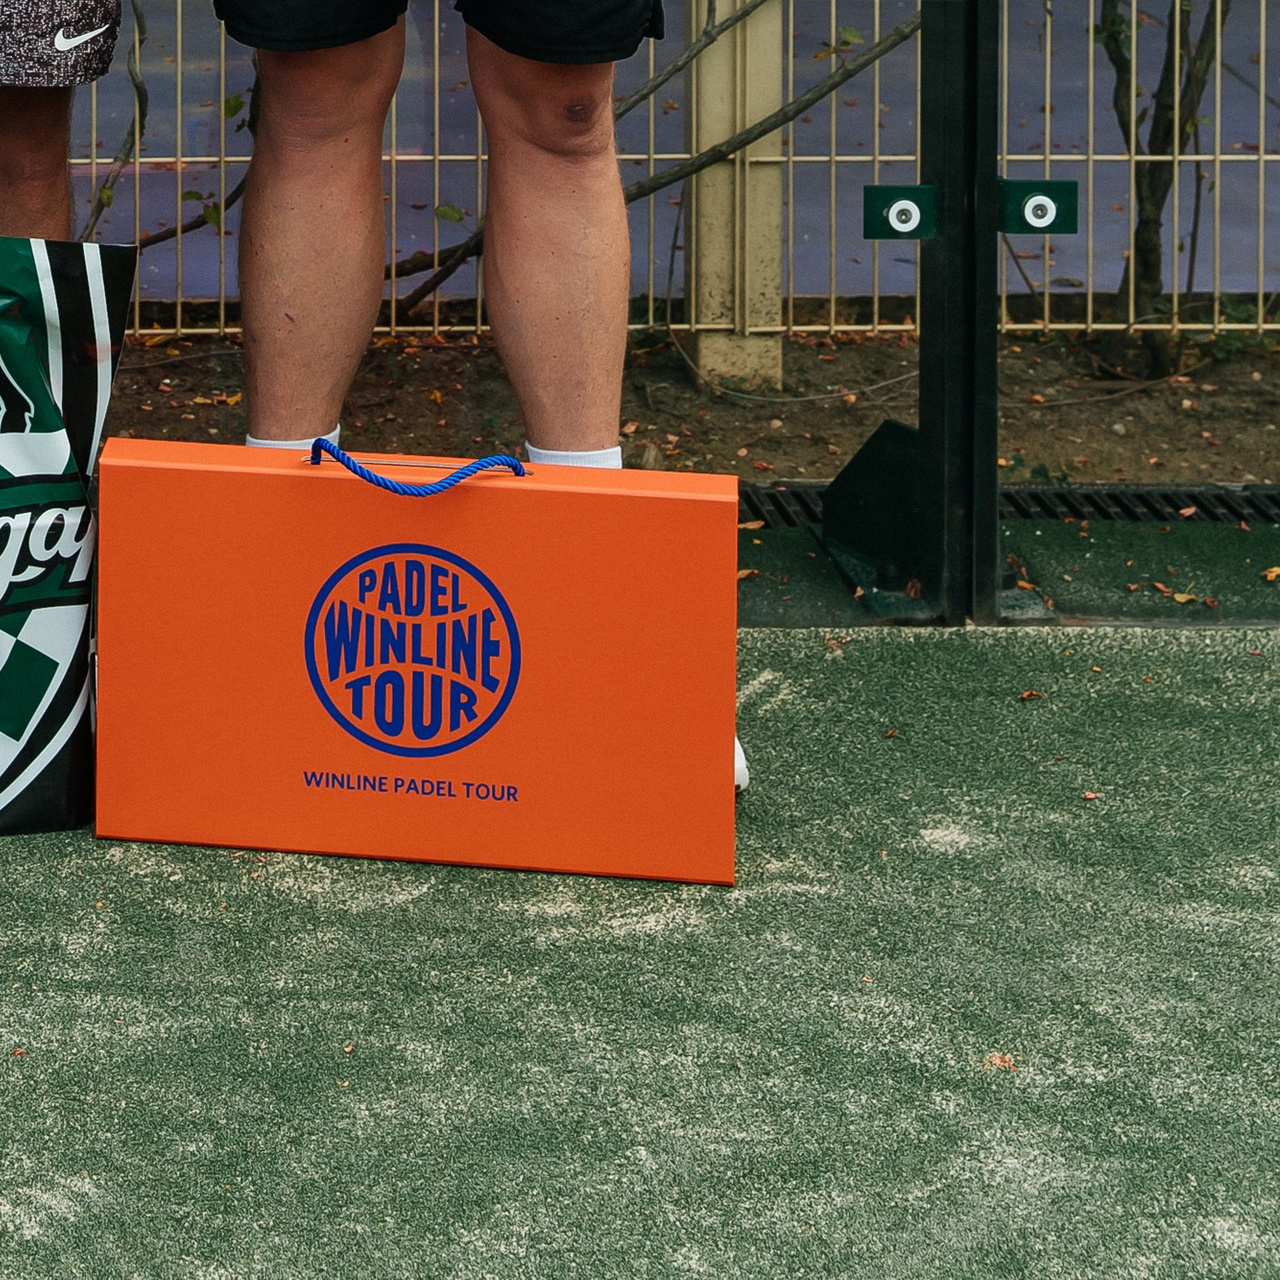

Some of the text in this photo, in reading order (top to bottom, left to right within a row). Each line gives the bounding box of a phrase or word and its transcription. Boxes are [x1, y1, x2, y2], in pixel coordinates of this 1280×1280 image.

[358, 559, 468, 617] PADEL
[323, 600, 501, 694] WINLINE
[345, 669, 479, 741] TOUR
[303, 771, 519, 802] WINLINE PADEL TOUR
